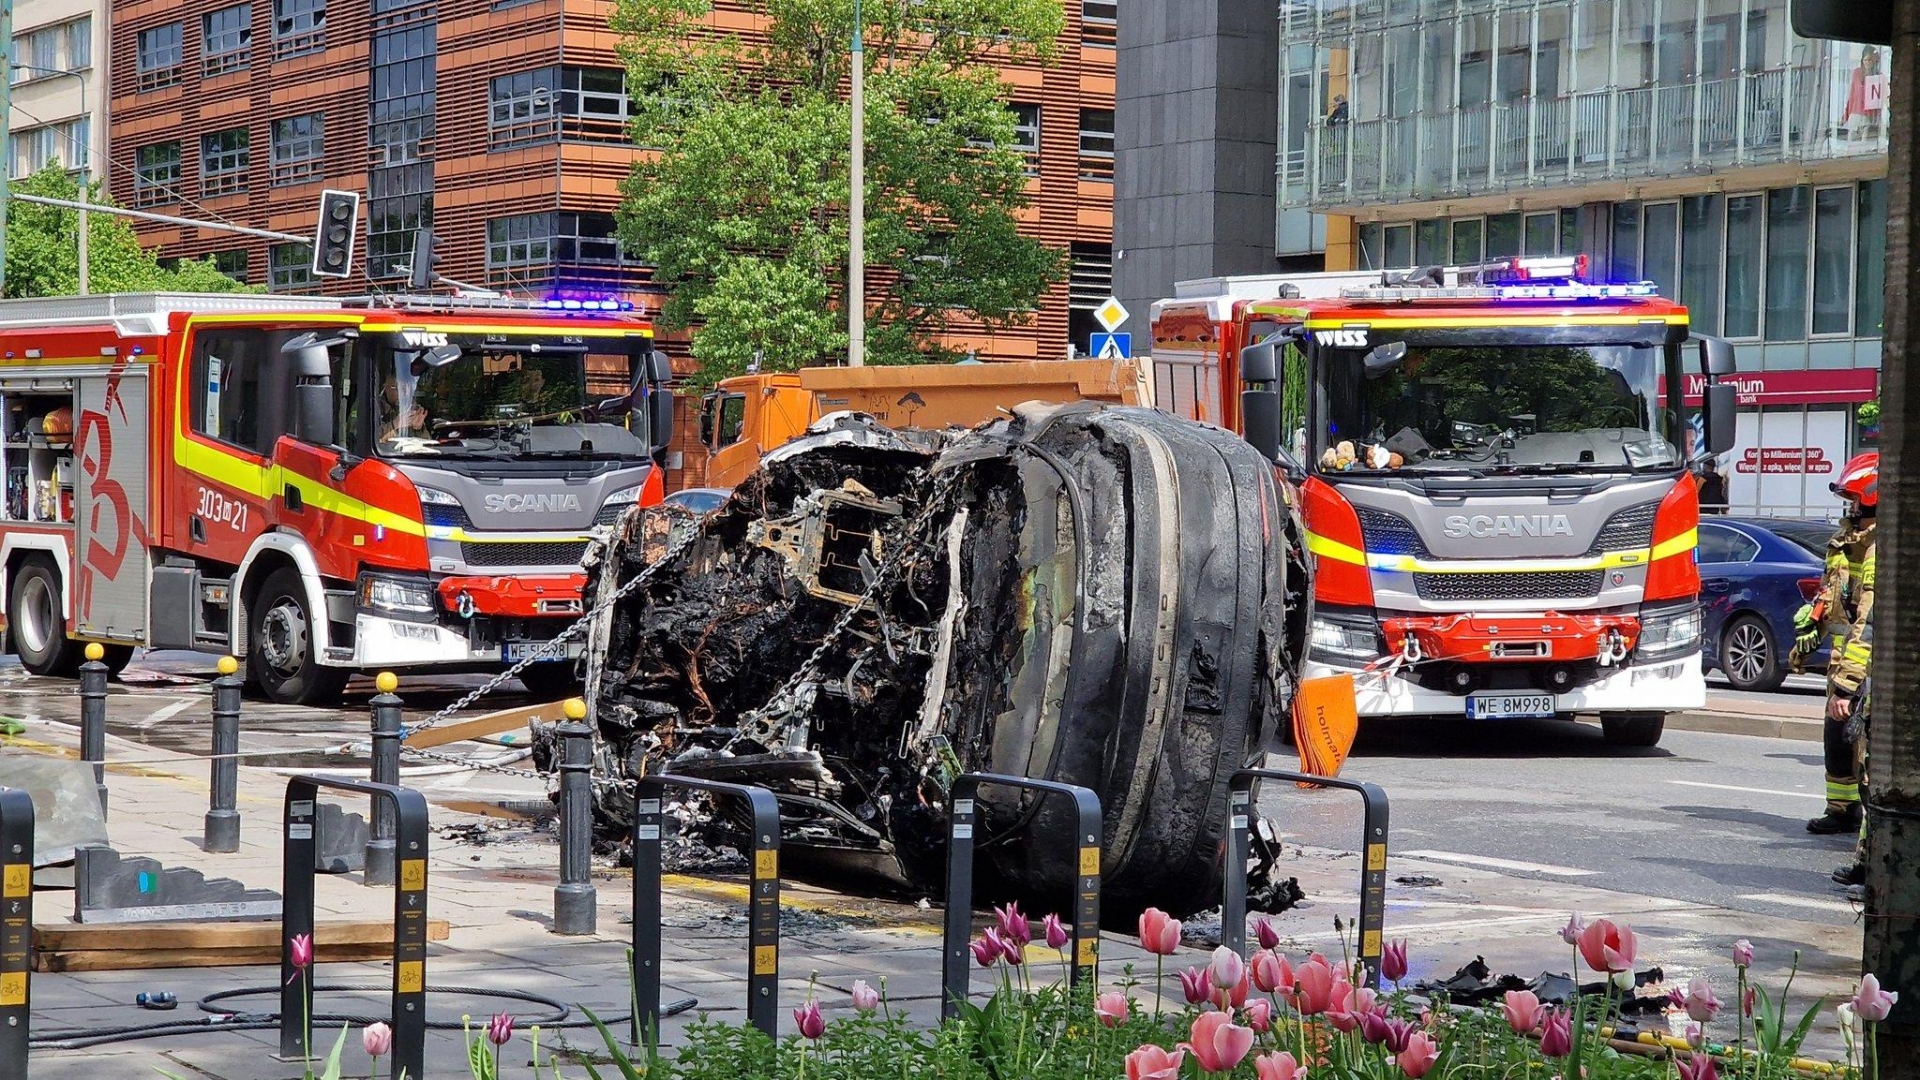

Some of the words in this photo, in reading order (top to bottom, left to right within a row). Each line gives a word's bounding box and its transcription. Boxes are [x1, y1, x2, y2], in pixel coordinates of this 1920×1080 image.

[1871, 83, 1881, 100] N
[401, 332, 448, 347] WISS
[1315, 330, 1368, 347] WISS
[1740, 395, 1758, 404] bank
[484, 493, 582, 513] SCANIA
[1443, 514, 1574, 539] SCANIA
[510, 645, 526, 658] WE
[1477, 698, 1497, 713] WE
[1503, 697, 1551, 713] 8M998
[173, 904, 196, 916] OF
